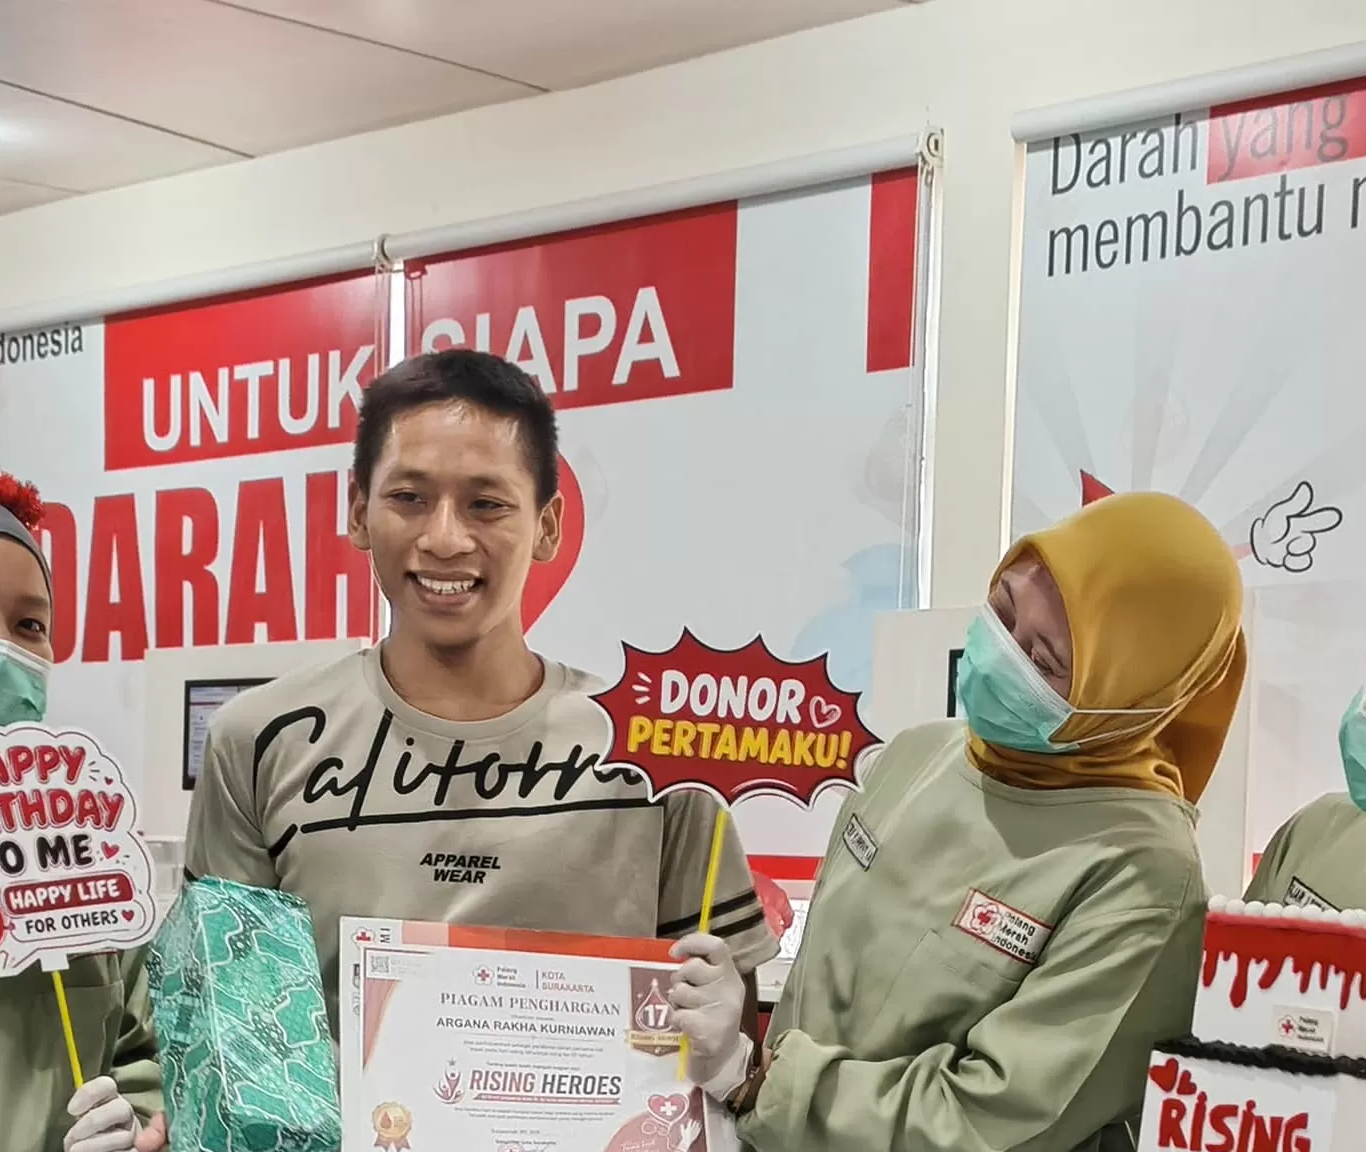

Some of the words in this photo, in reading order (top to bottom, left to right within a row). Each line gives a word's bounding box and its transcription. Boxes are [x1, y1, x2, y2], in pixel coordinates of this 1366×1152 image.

[1051, 112, 1198, 195] Darah
[1218, 95, 1349, 182] yang
[1047, 174, 1326, 277] membantu
[141, 344, 375, 452] UNTUK
[660, 669, 806, 724] DONOR
[626, 715, 853, 770] PERTAMAKU!
[36, 834, 95, 870] ME
[420, 853, 502, 870] APPAREL
[433, 868, 487, 884] WEAR
[9, 884, 75, 911] HAPPY
[77, 879, 121, 902] LIFE
[25, 916, 57, 935] FOR
[61, 909, 120, 933] OTHERS
[440, 992, 504, 1009] PIAGAM
[510, 996, 621, 1017] PENGHARGAAN
[644, 1004, 669, 1027] 17
[436, 1017, 491, 1029] ARGANA
[493, 1020, 537, 1033] RAKHA
[540, 1022, 616, 1037] KURNIAWAN
[469, 1069, 536, 1093] RISING
[541, 1073, 622, 1096] HEROES
